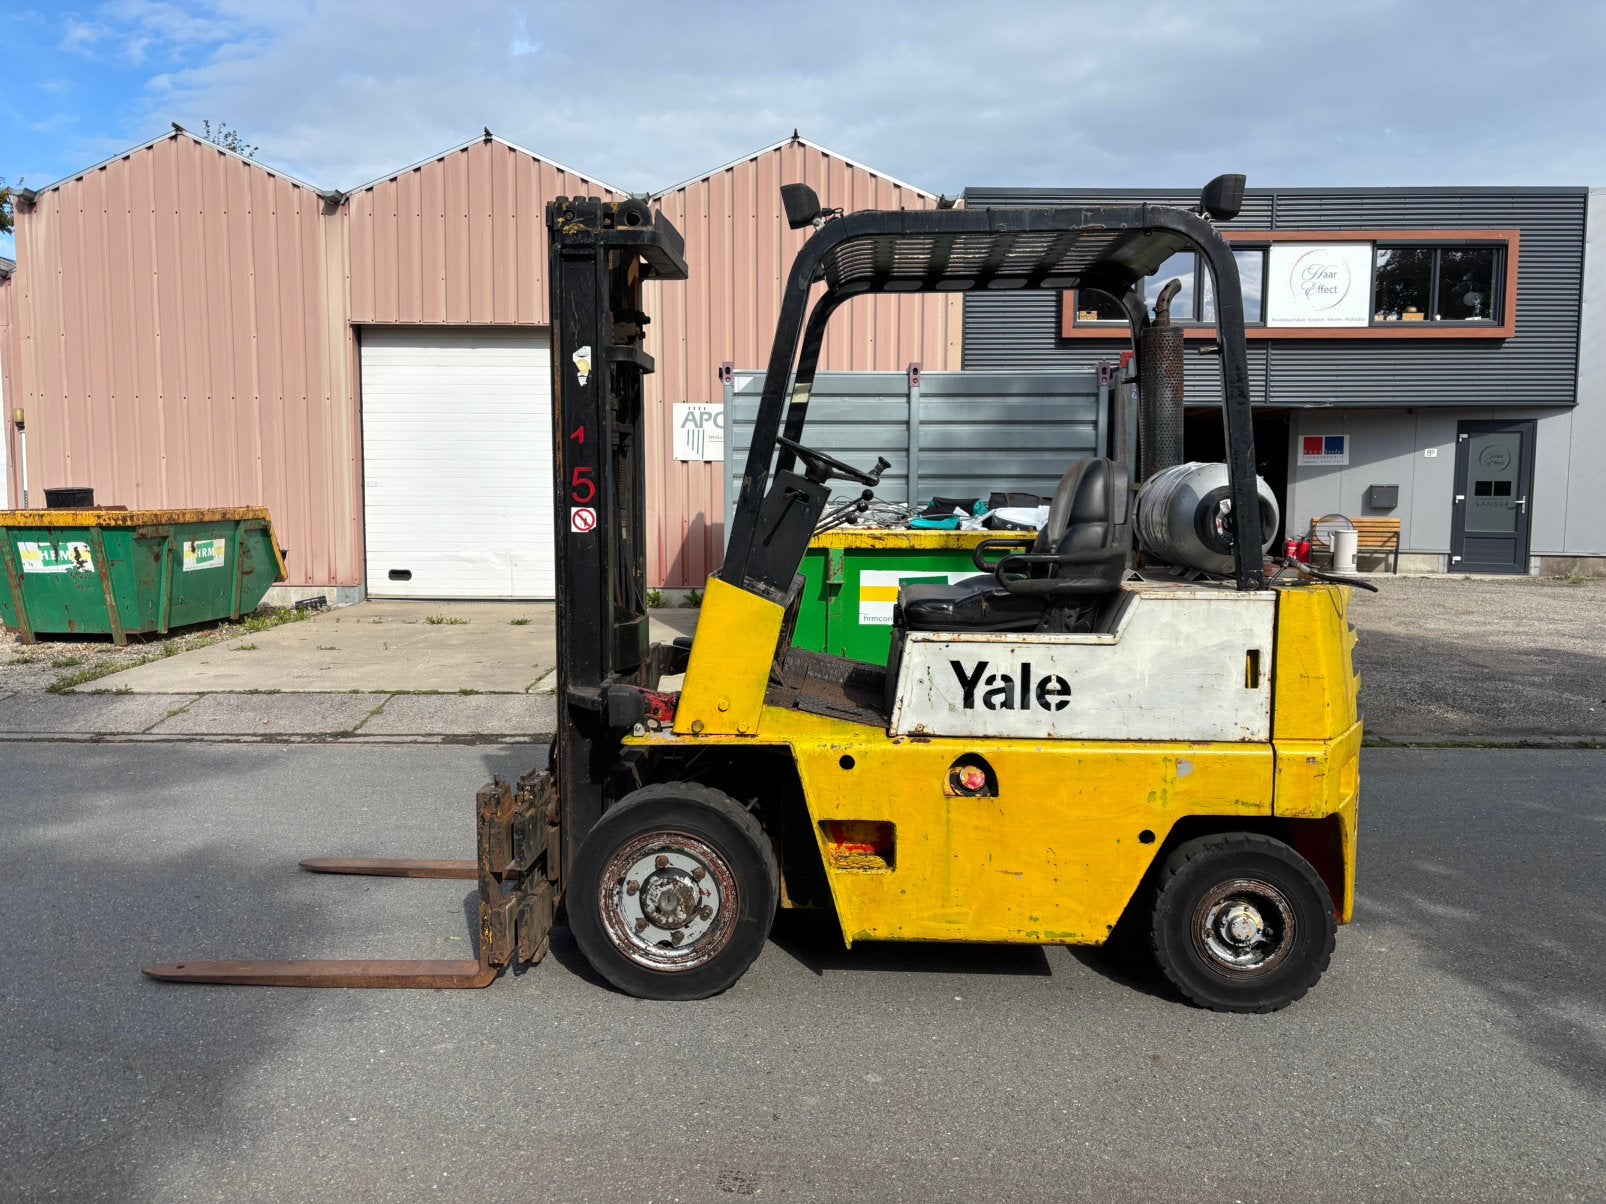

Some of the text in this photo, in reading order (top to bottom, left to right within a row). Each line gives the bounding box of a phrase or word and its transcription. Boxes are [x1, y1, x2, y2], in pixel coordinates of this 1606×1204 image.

[1301, 263, 1338, 281] Haar
[1301, 281, 1339, 300] Effect
[571, 466, 596, 504] 5
[949, 660, 1072, 712] Yale
